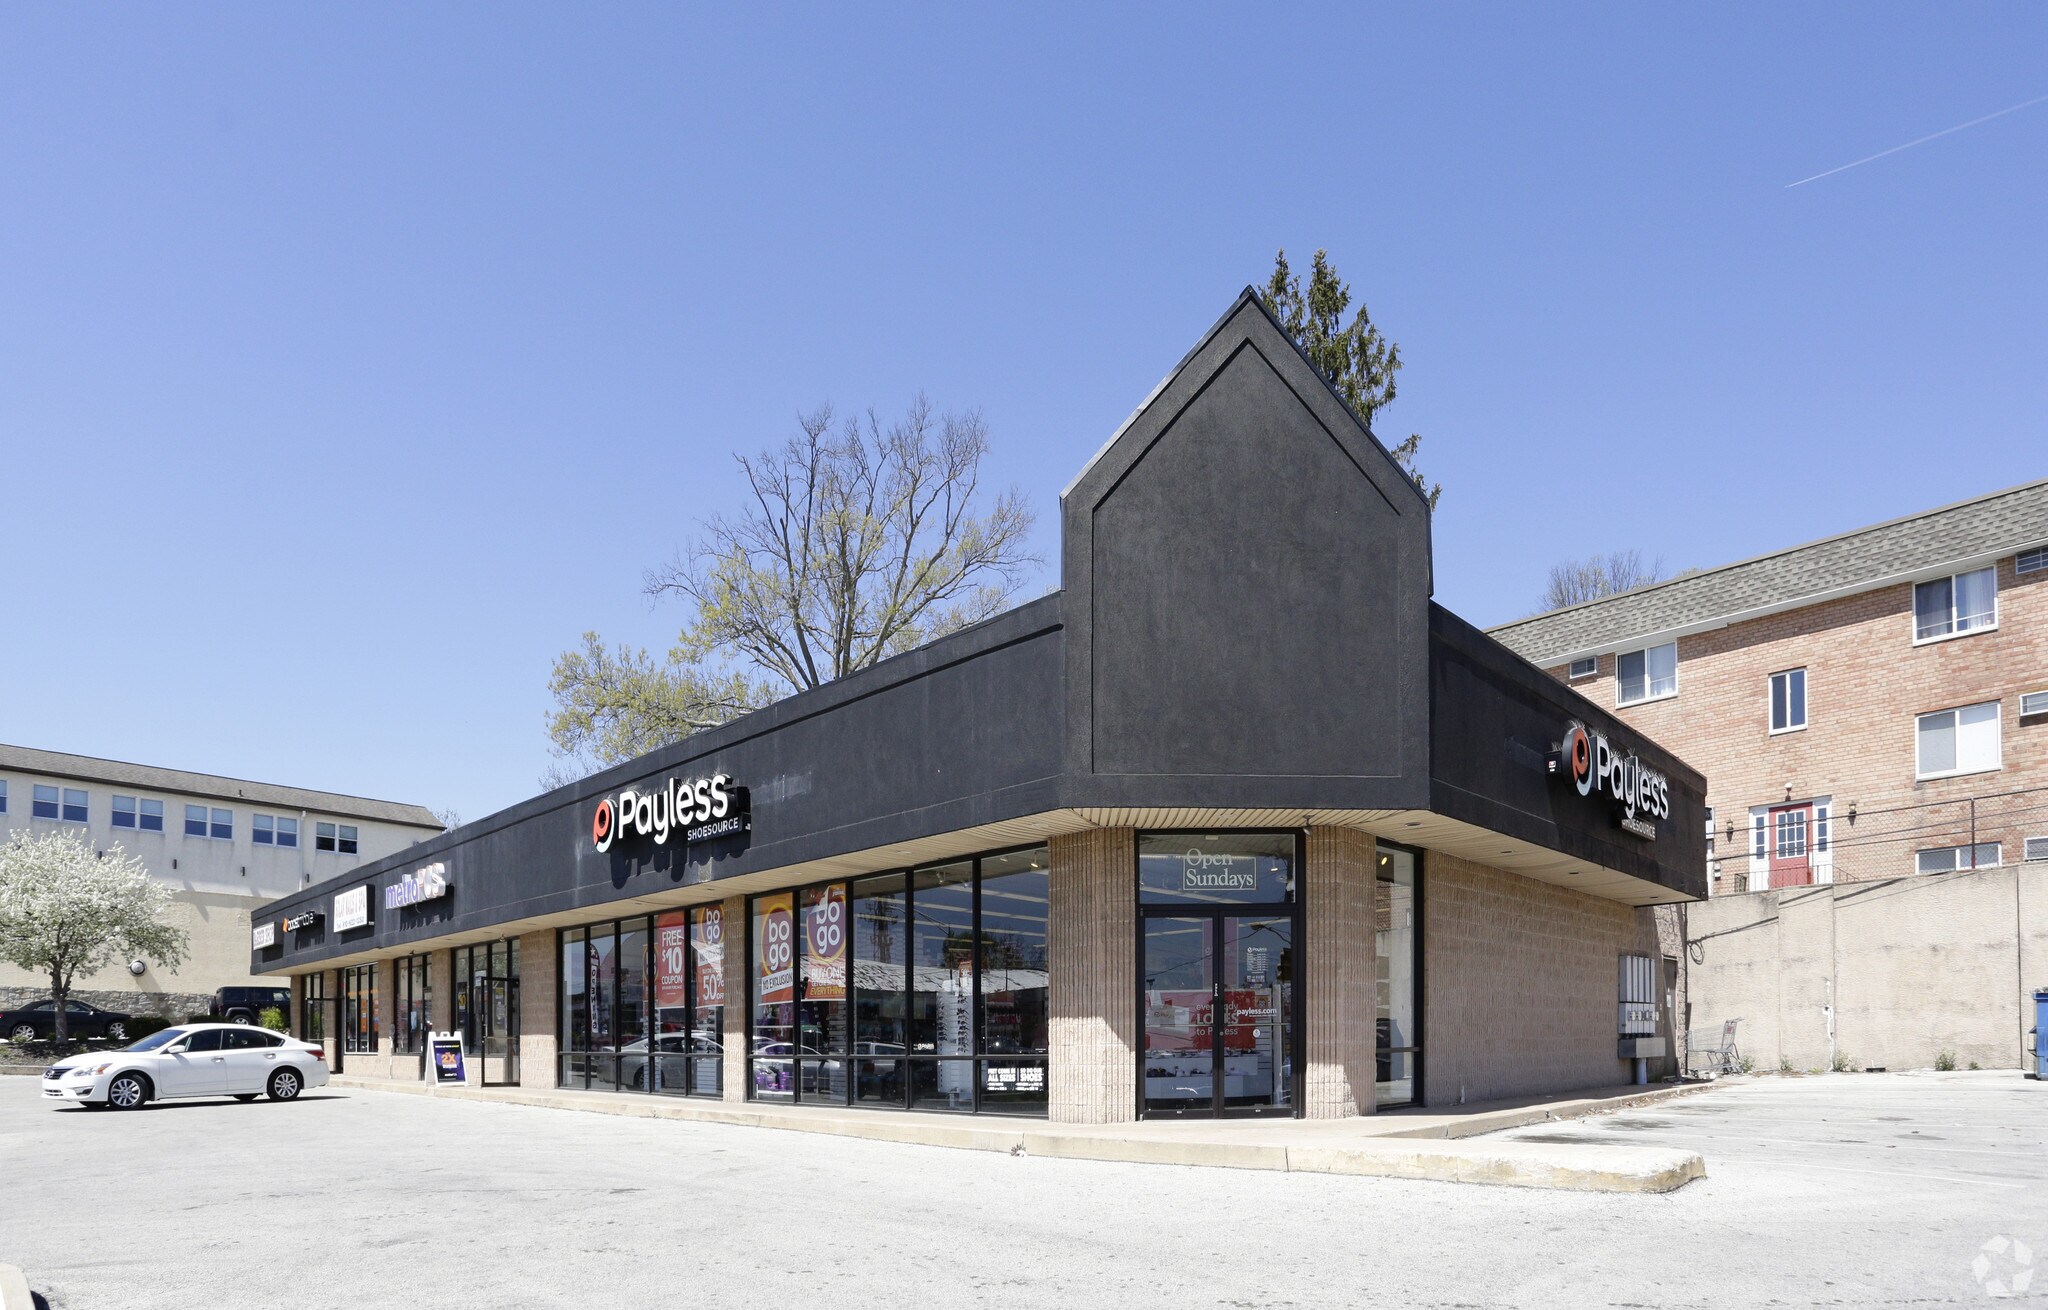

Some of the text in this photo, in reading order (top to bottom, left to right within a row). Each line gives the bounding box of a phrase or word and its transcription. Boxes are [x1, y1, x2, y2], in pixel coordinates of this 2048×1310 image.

[1597, 736, 1669, 819] Payless
[618, 774, 730, 845] Payless
[687, 817, 739, 841] SHOESOURCE
[1186, 848, 1234, 869] Open
[1186, 868, 1254, 889] Sundays
[661, 930, 682, 947] FREE
[661, 946, 683, 974] $10
[661, 975, 683, 985] COUPON
[810, 986, 845, 996] EVERYTHING
[1196, 1012, 1239, 1025] LOES
[1236, 1007, 1277, 1017] payless.com
[1196, 1027, 1239, 1036] to Pess
[441, 1053, 456, 1064] 2X
[1020, 1074, 1042, 1082] SHOES
